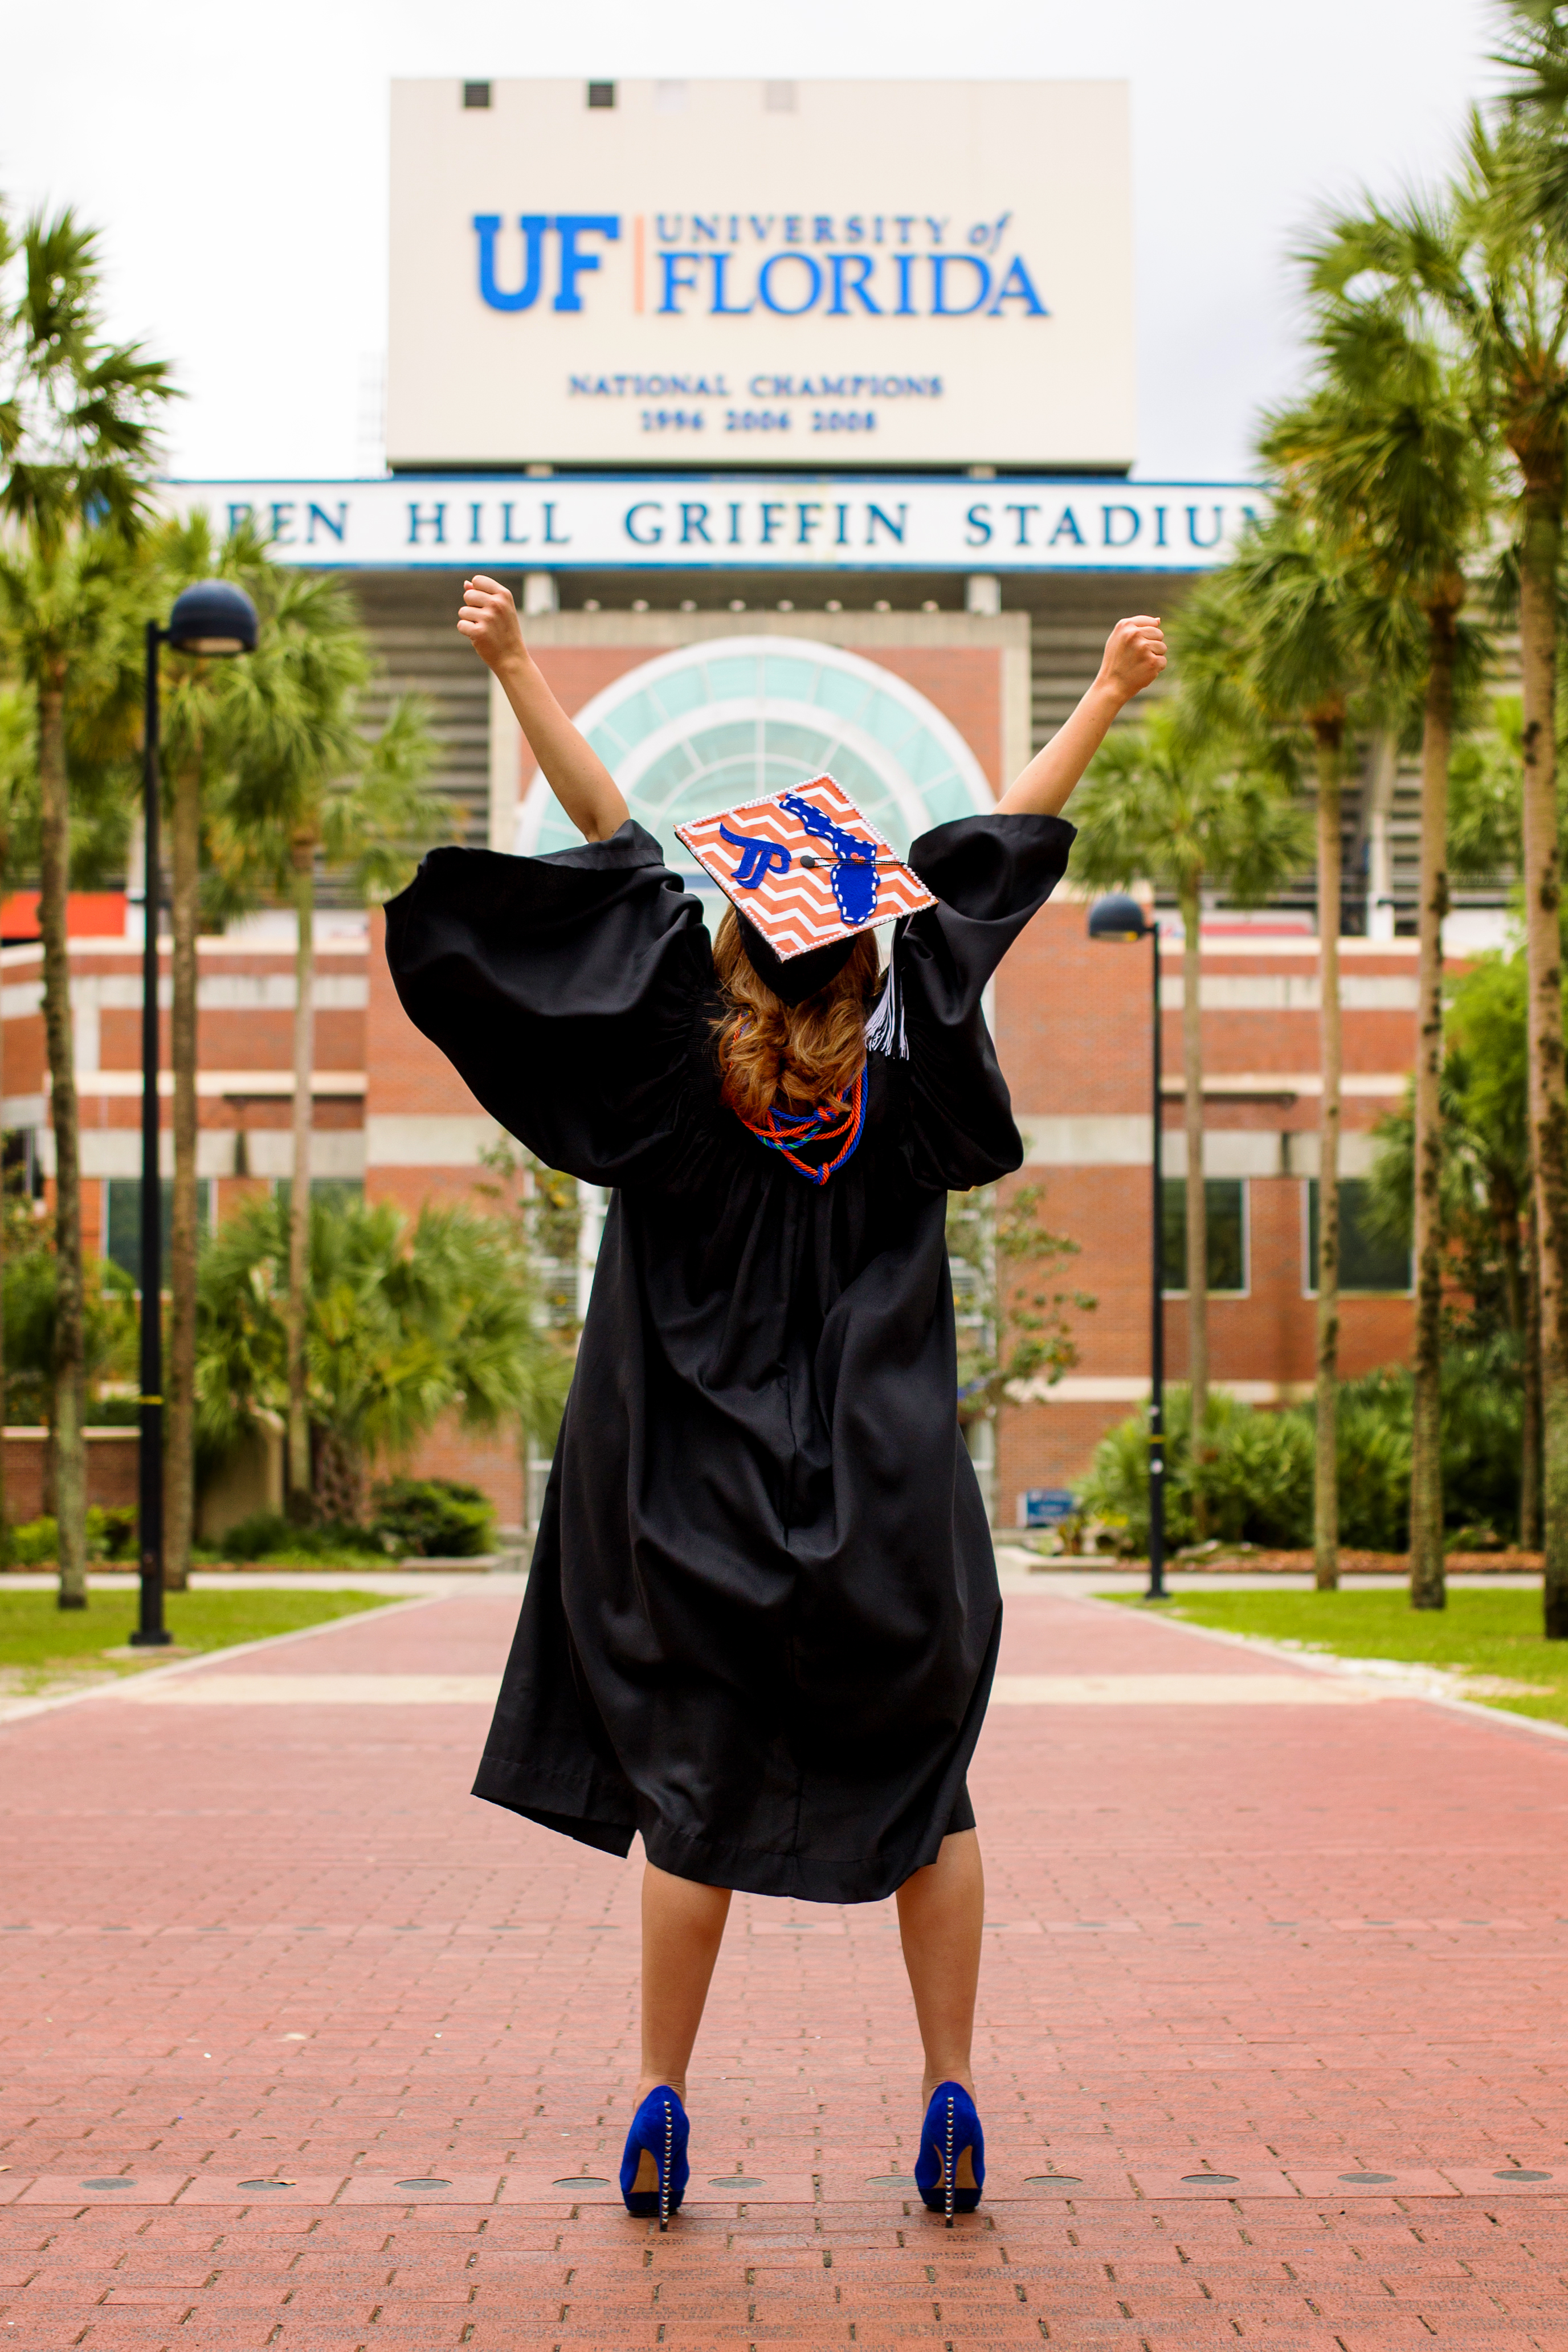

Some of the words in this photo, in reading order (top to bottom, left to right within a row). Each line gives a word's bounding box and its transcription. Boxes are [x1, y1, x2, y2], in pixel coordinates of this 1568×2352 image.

[657, 214, 941, 243] UNIVERSITY
[967, 213, 1012, 254] of
[471, 213, 622, 312] UF
[658, 251, 1050, 316] FLORIDA
[569, 374, 726, 395] NATIONAL
[749, 374, 943, 395] CHAMPIONS
[406, 501, 570, 544] HILL
[623, 501, 909, 544] GRIFFIN
